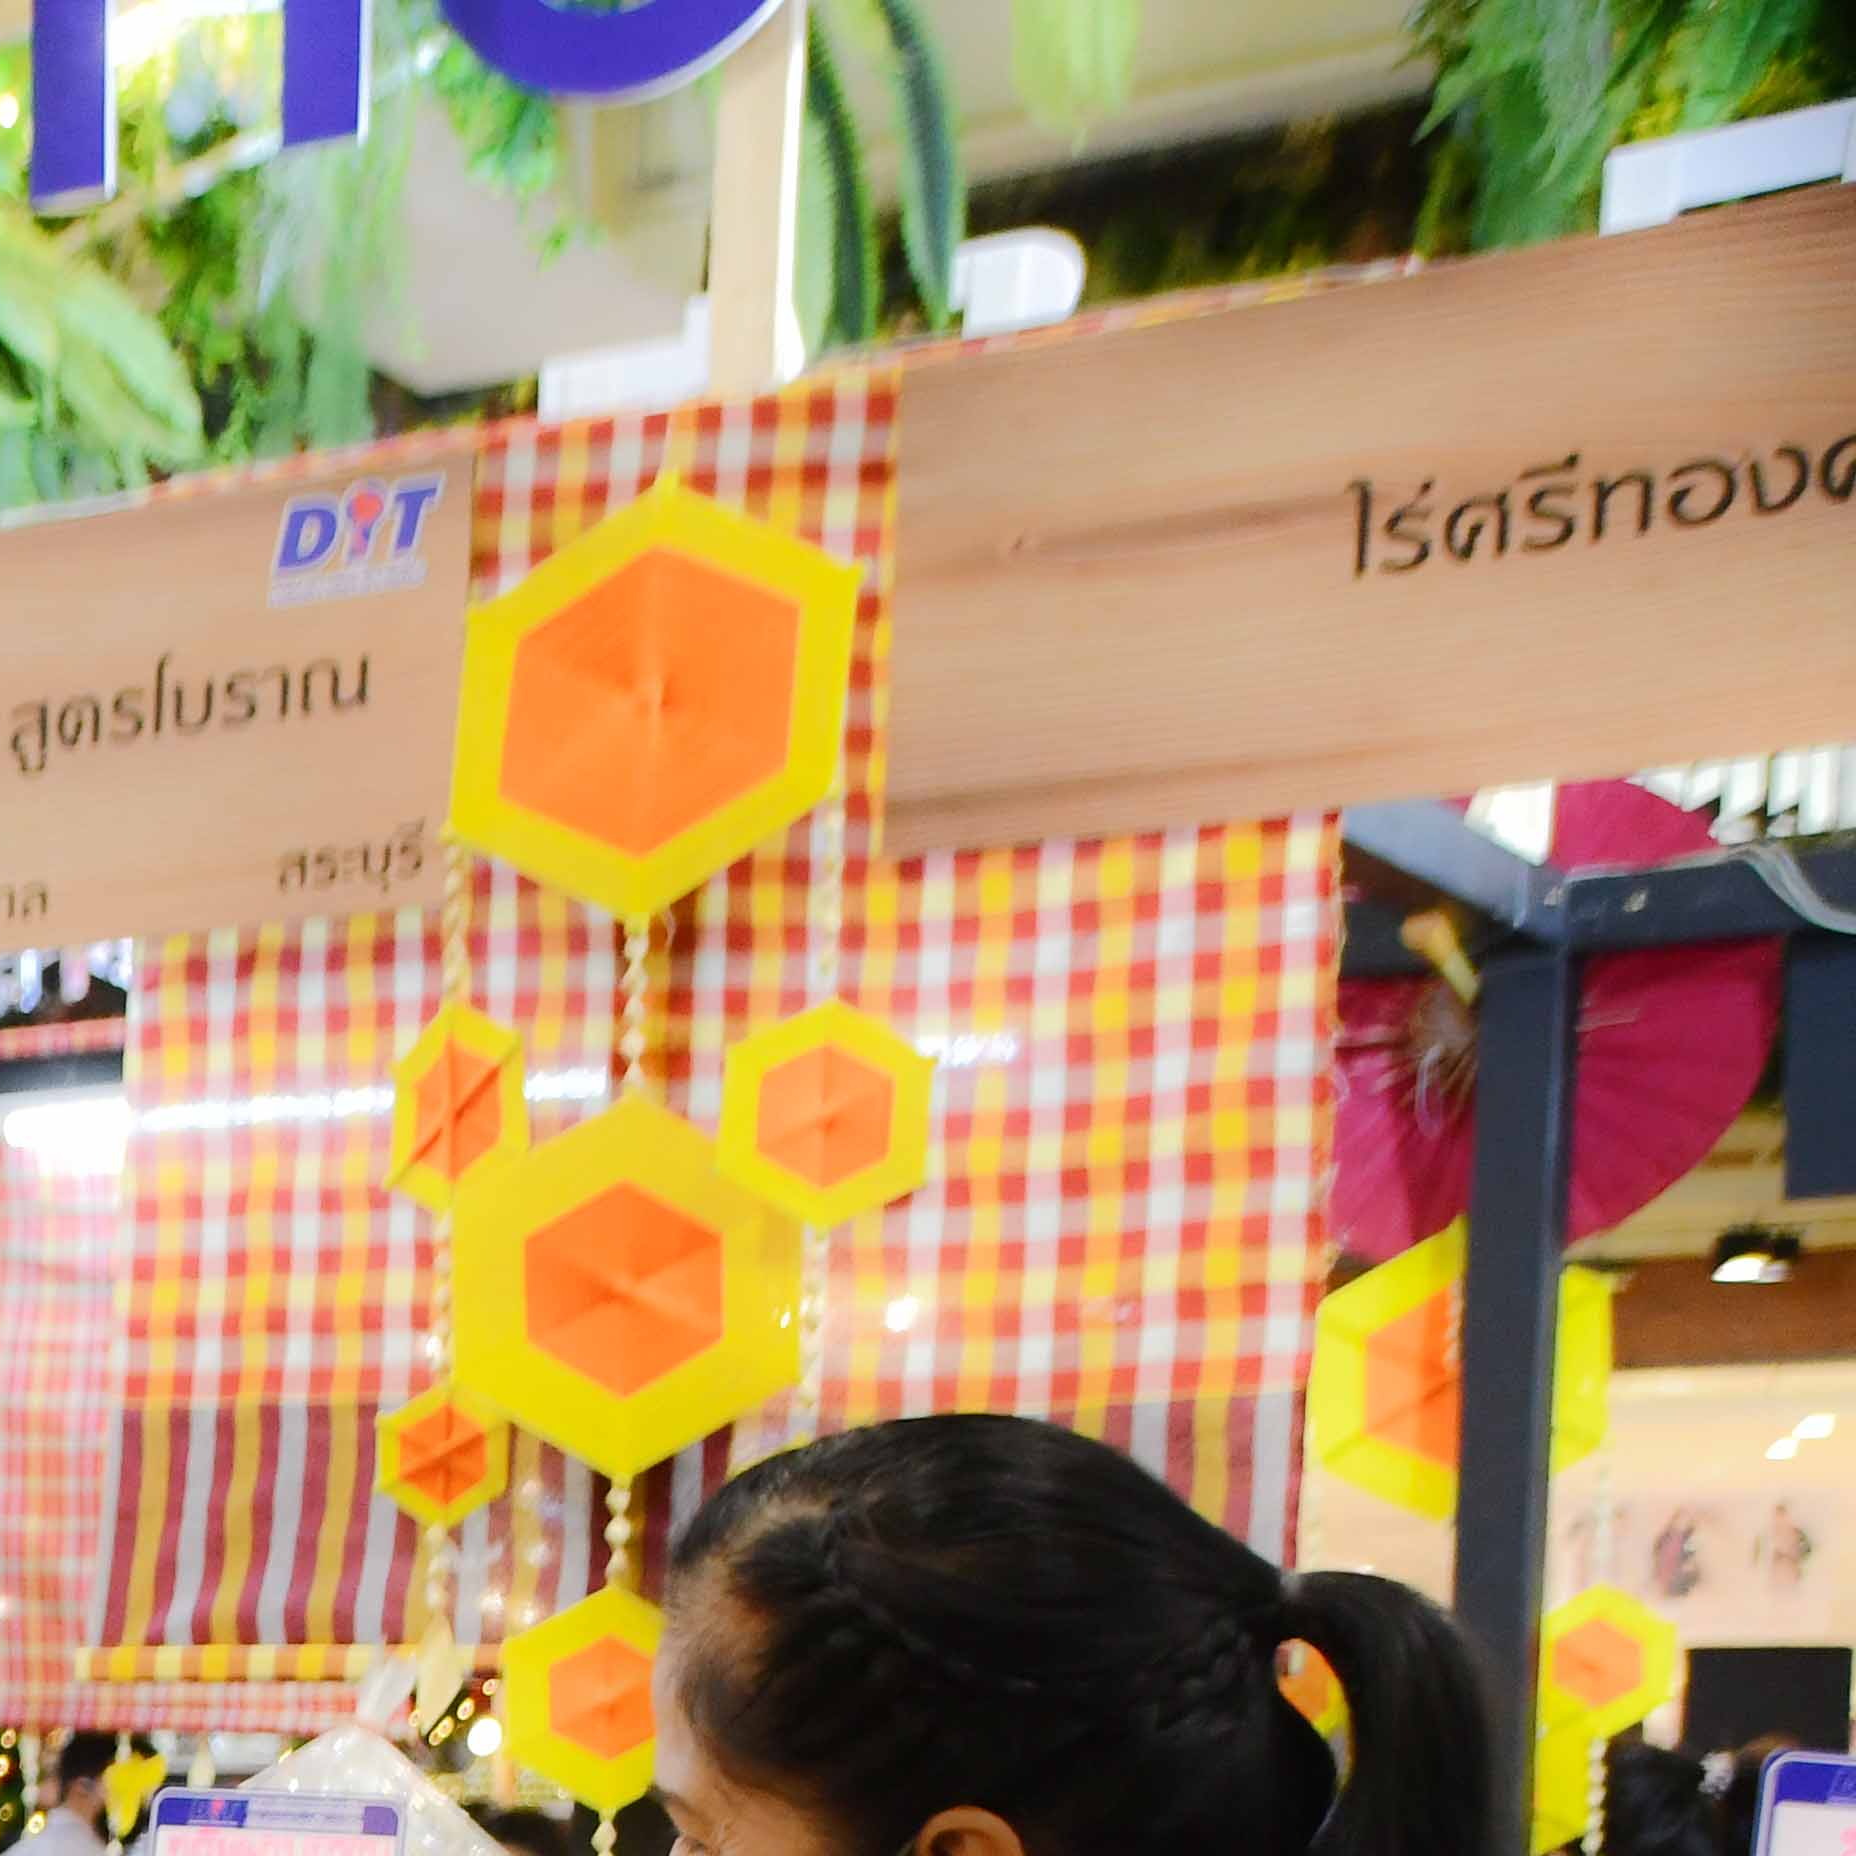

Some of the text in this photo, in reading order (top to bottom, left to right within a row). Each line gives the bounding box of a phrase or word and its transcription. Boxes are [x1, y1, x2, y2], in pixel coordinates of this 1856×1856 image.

[10, 650, 370, 777] สูตรโบราณ
[277, 815, 428, 895] สระบุรี
